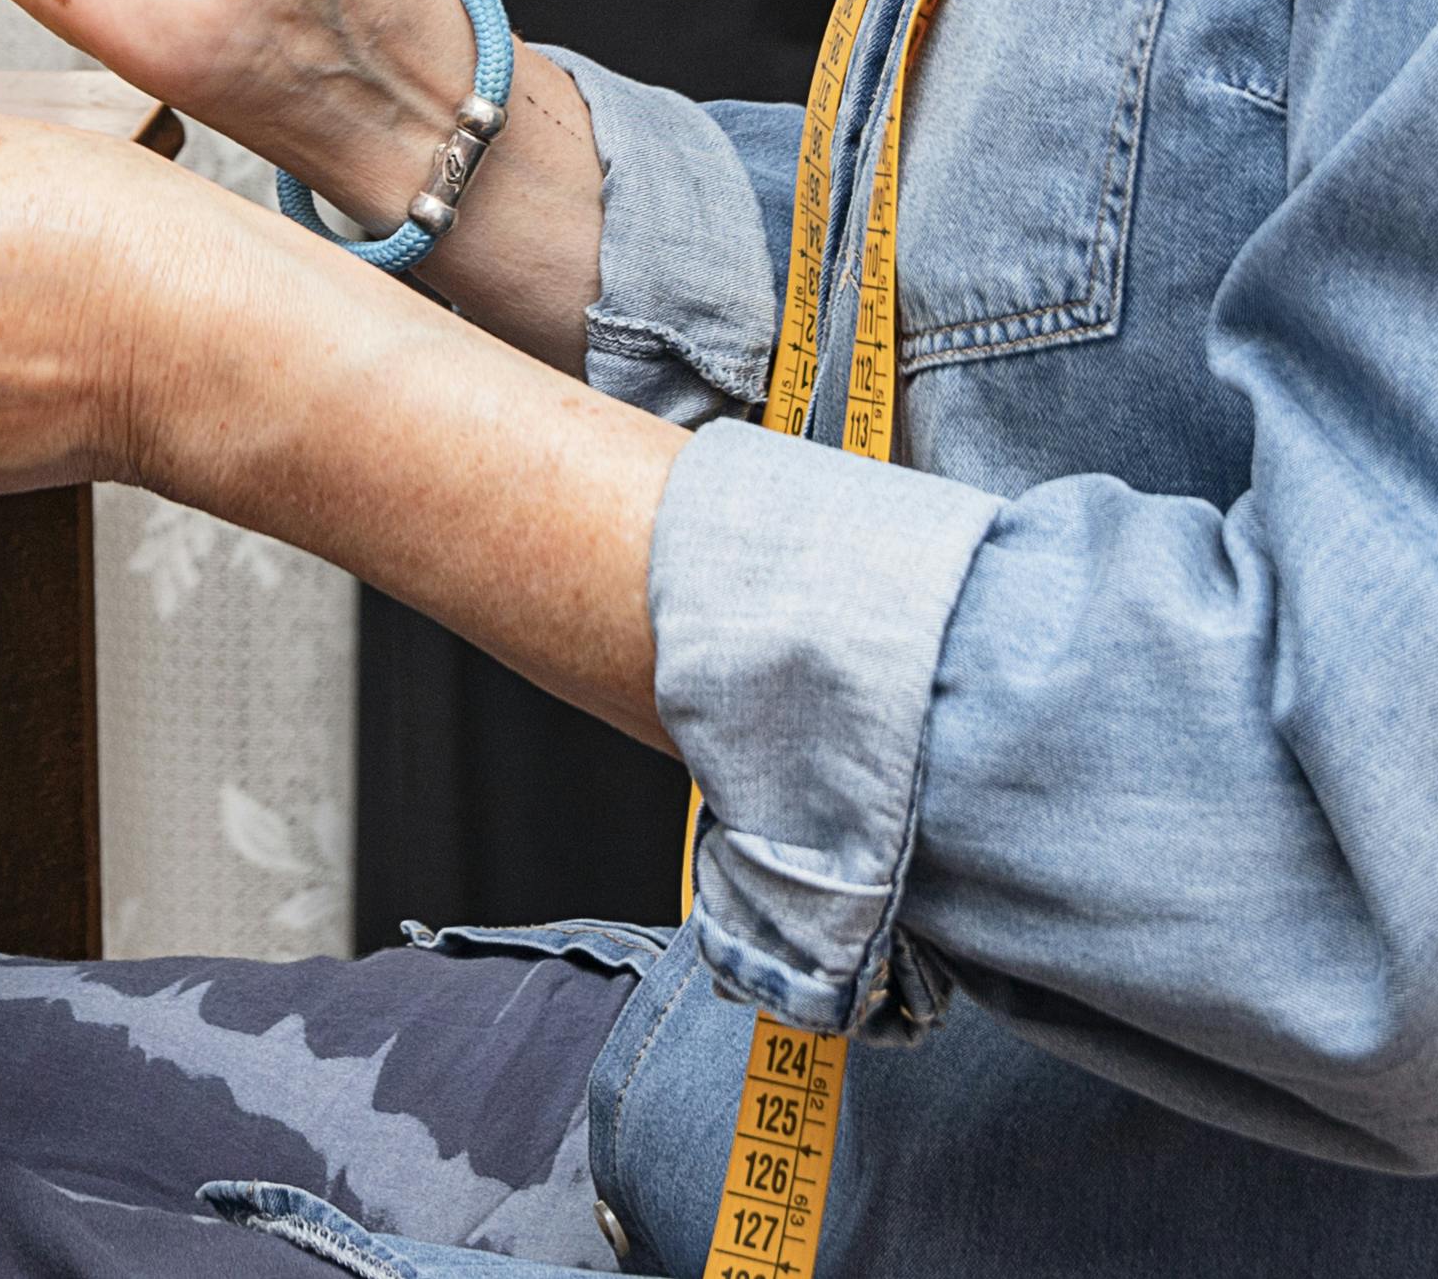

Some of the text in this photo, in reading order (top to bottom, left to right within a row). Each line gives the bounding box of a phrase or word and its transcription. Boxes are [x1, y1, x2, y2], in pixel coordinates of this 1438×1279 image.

[855, 354, 872, 391] 112
[849, 411, 869, 448] 113
[766, 1035, 808, 1079] 124
[810, 1077, 827, 1111] 62
[756, 1092, 799, 1137] 125
[745, 1150, 789, 1194] 126
[790, 1193, 808, 1227] 63
[733, 1209, 779, 1252] 127
